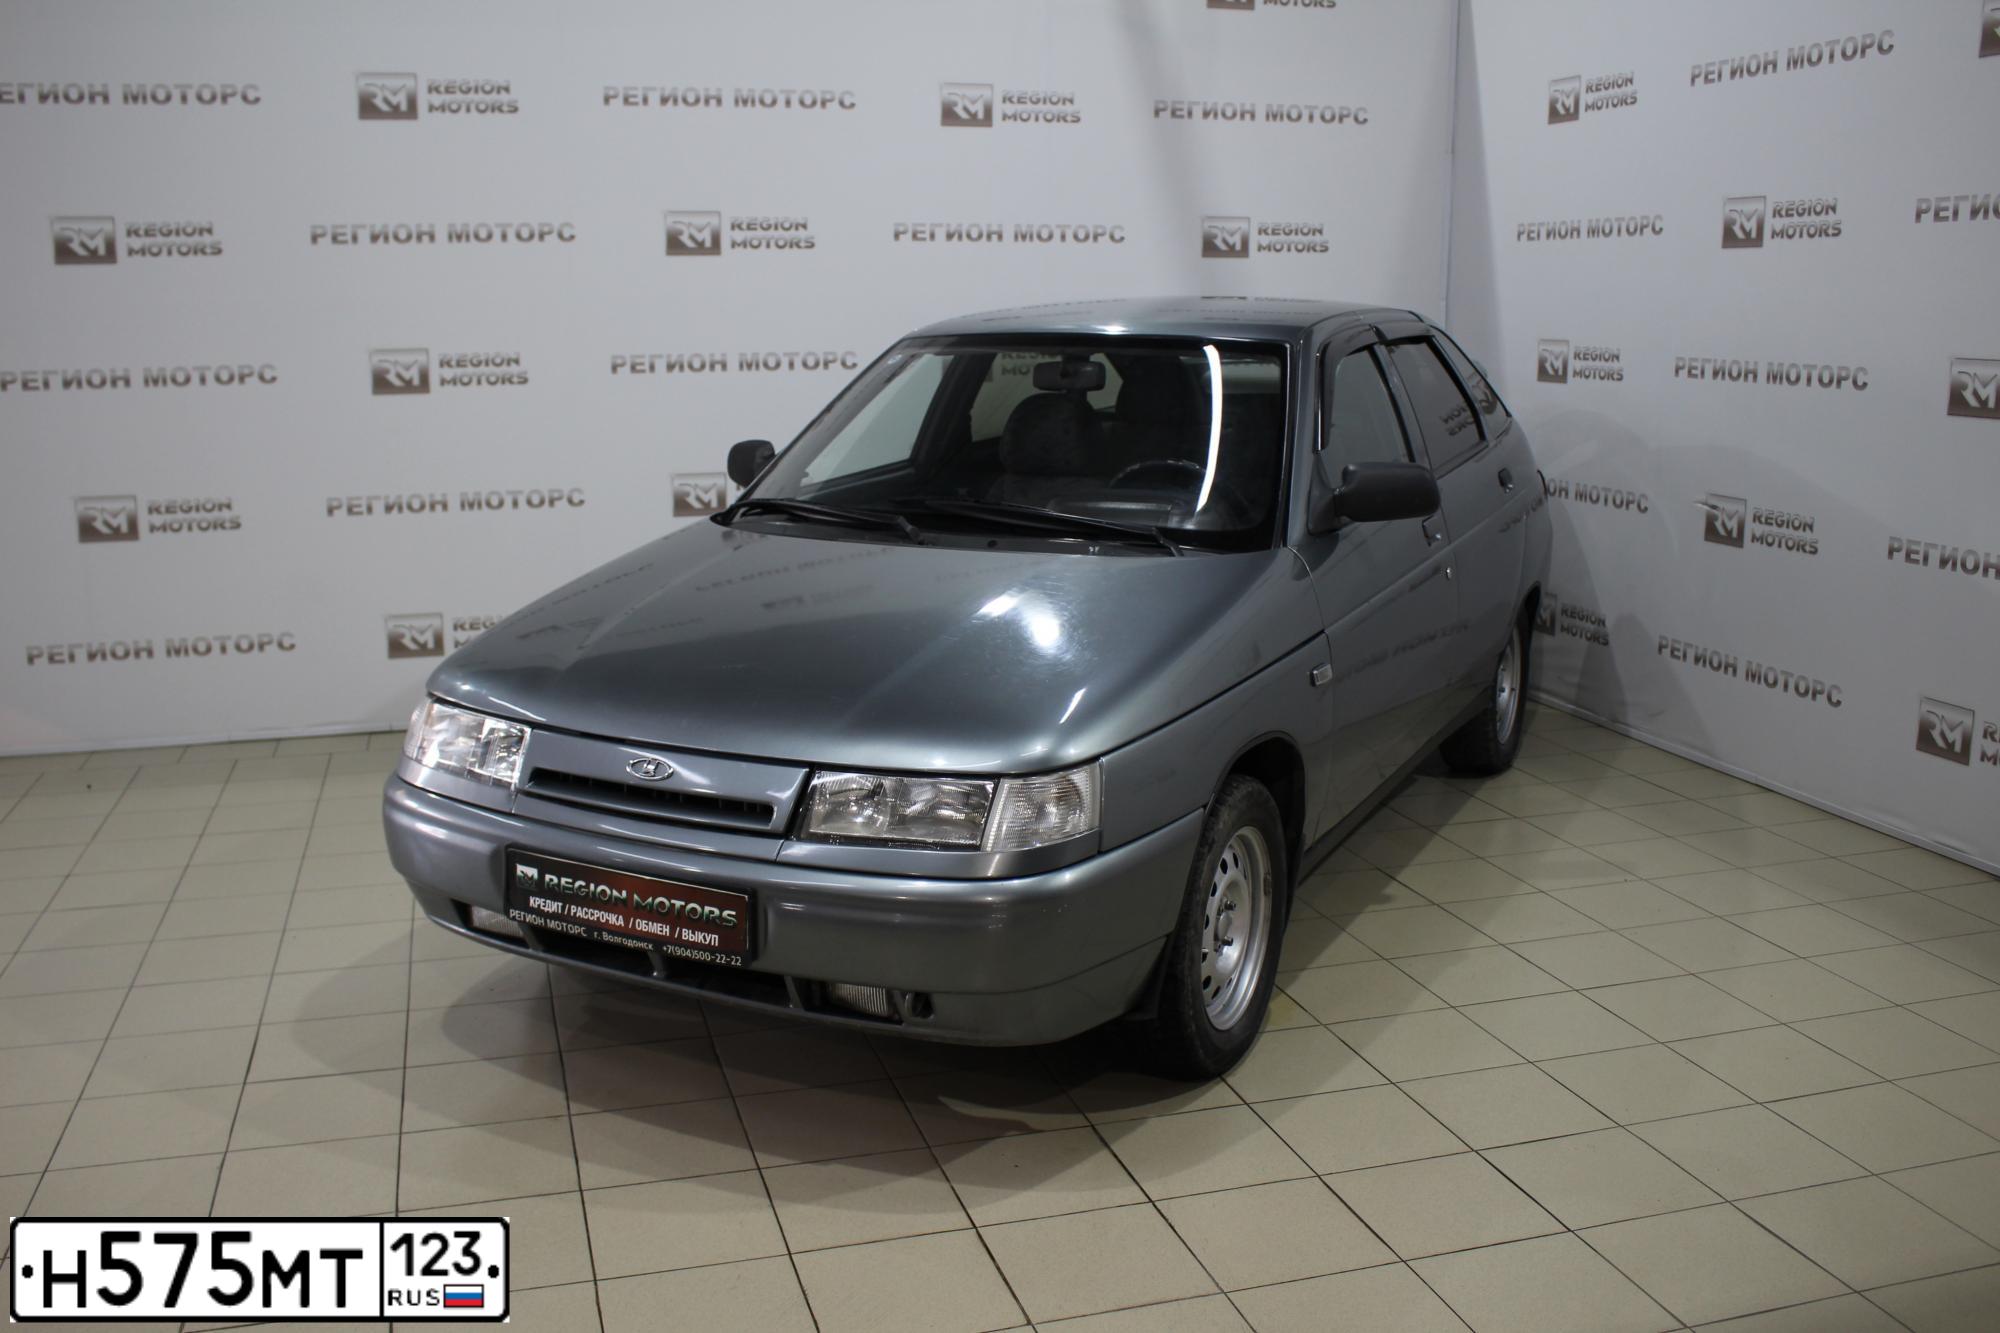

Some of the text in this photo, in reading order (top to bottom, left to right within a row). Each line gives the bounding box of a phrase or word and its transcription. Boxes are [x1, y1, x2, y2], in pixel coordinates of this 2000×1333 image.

[1690, 29, 1895, 87] РЕГИОН МОТОРС
[426, 79, 511, 96] REGION
[1585, 72, 1634, 93] REGION
[122, 83, 262, 106] МОТОРС
[602, 86, 857, 111] РЕГИОН МОТОРС
[1001, 90, 1075, 106] REGION
[1584, 92, 1638, 112] MOTORS
[427, 99, 520, 115] MOTORS
[1001, 109, 1082, 124] MOTORS
[1153, 99, 1369, 126] РЕГИОН МОТОРС
[1772, 198, 1838, 219] REGION
[125, 221, 214, 238] REGION
[310, 222, 576, 246] РЕГИОН МОТОРС
[730, 217, 808, 232] REGION
[893, 223, 1126, 244] РЕГИОН МОТОРС
[1257, 222, 1324, 237] REGION
[1516, 214, 1664, 242] РЕГИОН МОТОРС
[1771, 219, 1842, 241] MOTORS
[126, 241, 224, 258] MOTORS
[730, 234, 816, 250] MOTORS
[1256, 239, 1330, 254] MOTORS
[438, 353, 521, 368] REGION
[610, 351, 859, 375] РЕГИОН МОТОРС
[1573, 346, 1621, 363] REGION
[0, 363, 278, 393] РЕГИОН МОТОРС
[439, 370, 530, 387] MOTORS
[1573, 365, 1624, 382] MOTORS
[1674, 357, 1869, 392] РЕГИОН МОТОРС
[147, 498, 233, 516] REGION
[326, 487, 586, 518] РЕГИОН МОТОРС
[1574, 483, 1649, 514] МОТОРС
[148, 516, 242, 534] MOTORS
[1752, 508, 1815, 532] REGION
[1751, 533, 1818, 555] MOTORS
[1887, 536, 2000, 581] РЕГИОН
[1561, 603, 1606, 627] REGION
[1560, 623, 1609, 647] MOTORS
[26, 632, 296, 667] РЕГИОН МОТОРС
[1657, 636, 1842, 708] РЕГИОН МОТОРС
[544, 874, 737, 926] REGION MOTORS
[529, 896, 563, 915] КРЕДИТ
[571, 905, 624, 927] РАССРОЧКА
[636, 919, 669, 936] ОБМЕН
[682, 928, 719, 947] ВЫКУП
[510, 909, 544, 927] РЕГИОН
[547, 915, 587, 936] МОТОРС
[603, 932, 653, 951] Волгодонск
[663, 944, 742, 966] +7(904)500-22-22
